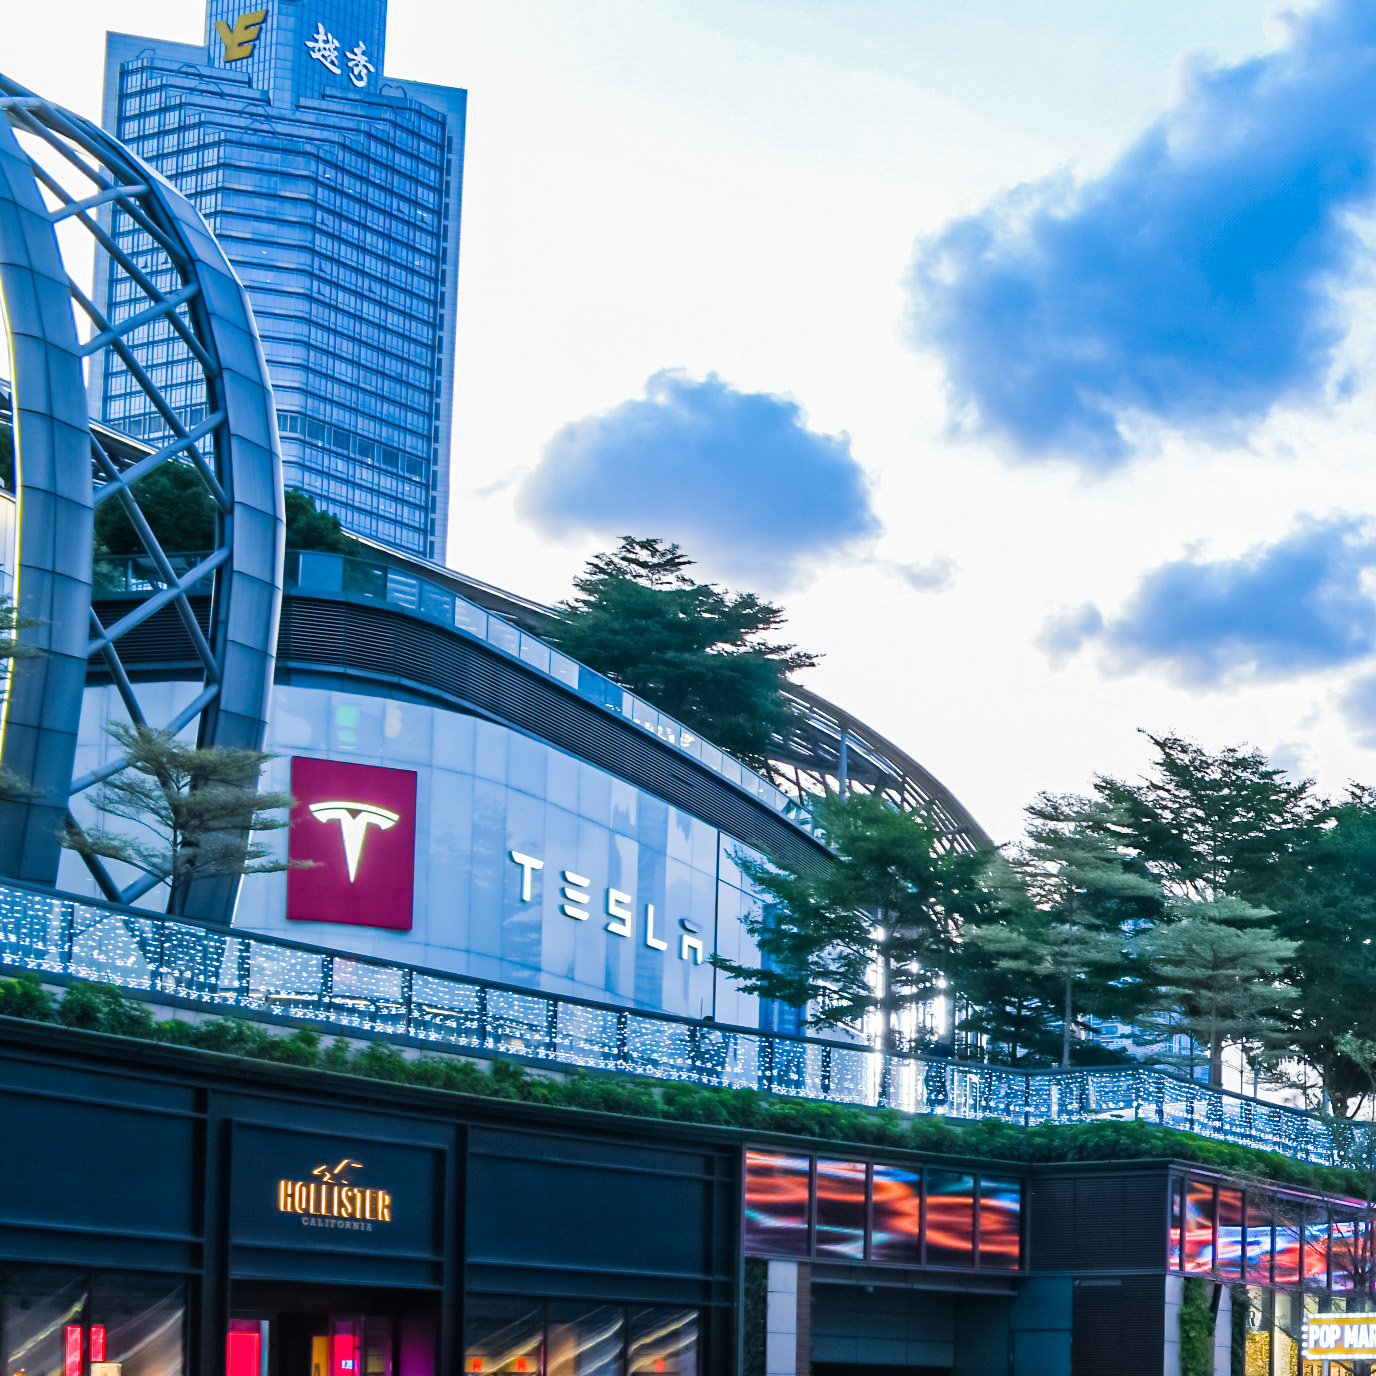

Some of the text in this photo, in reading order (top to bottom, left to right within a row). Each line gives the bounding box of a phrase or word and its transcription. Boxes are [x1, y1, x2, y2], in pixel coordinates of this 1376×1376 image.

[305, 23, 375, 88] 越秀
[511, 850, 702, 965] TESLA
[279, 1179, 391, 1222] HOLLISTER
[301, 1216, 373, 1231] CALIFORNIA
[1308, 1324, 1341, 1348] POP
